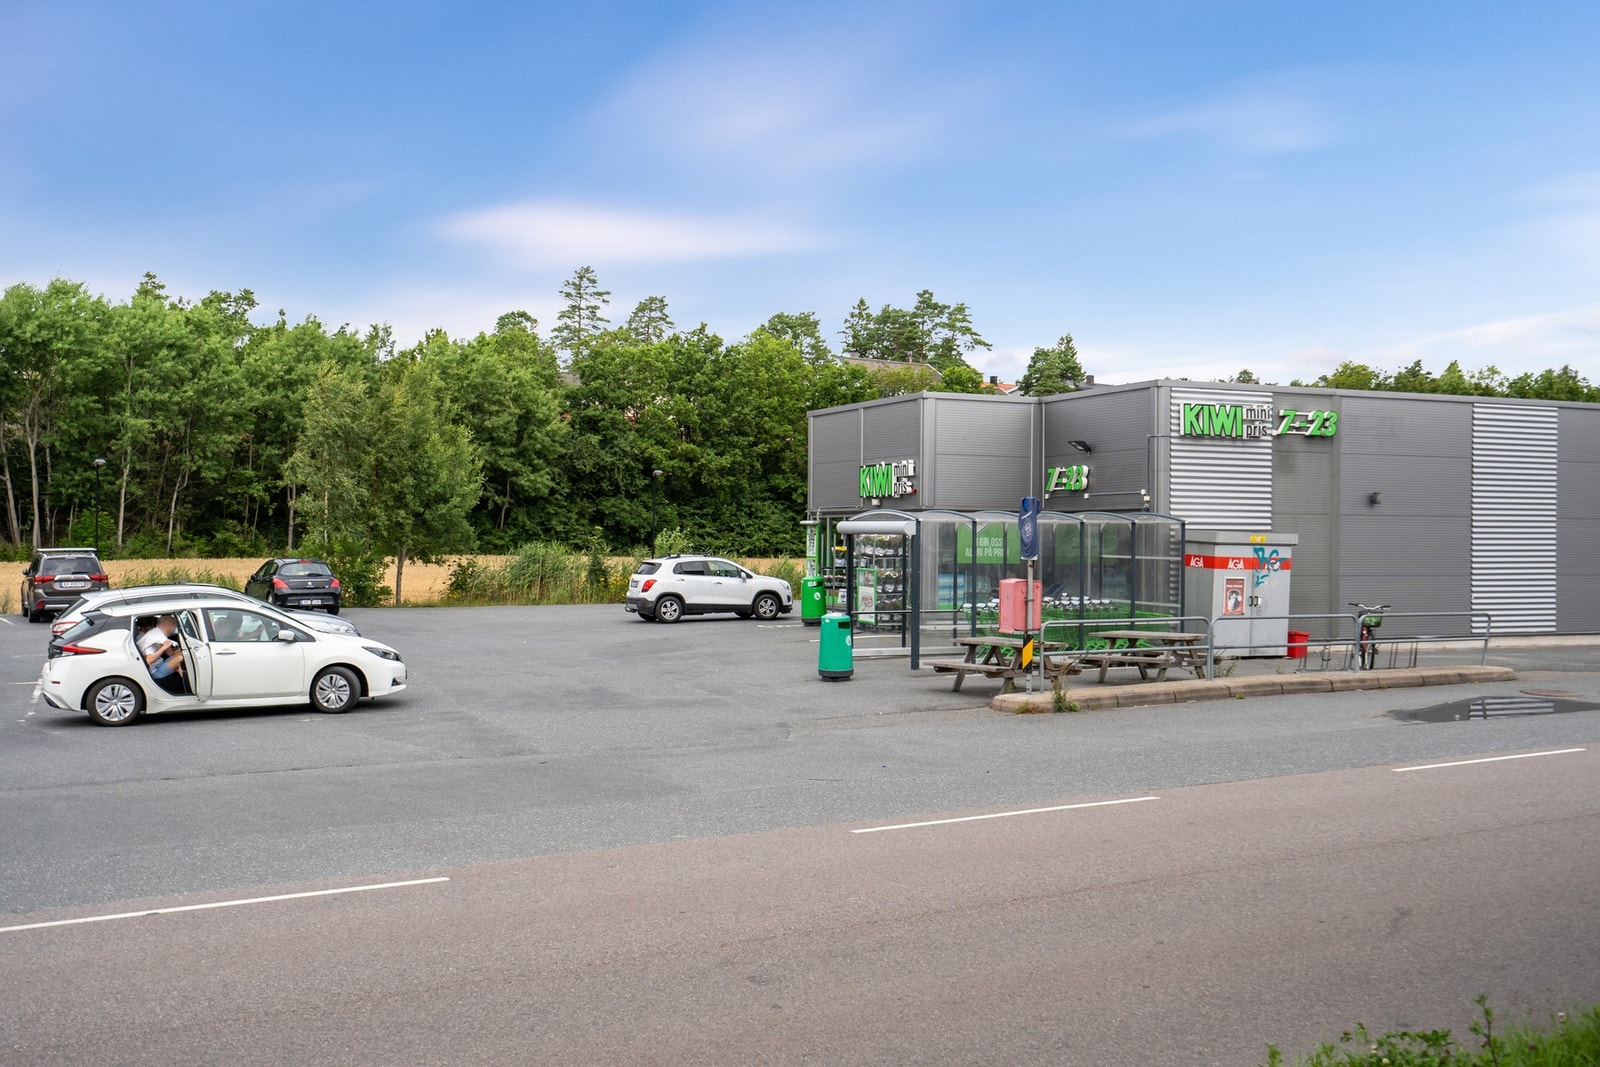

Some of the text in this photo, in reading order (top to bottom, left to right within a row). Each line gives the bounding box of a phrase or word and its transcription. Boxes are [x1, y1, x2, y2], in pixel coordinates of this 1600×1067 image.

[1183, 403, 1271, 438] KIWI mini
[1246, 422, 1268, 438] pris
[1278, 409, 1339, 438] 7-23
[859, 463, 892, 498] KIWI
[894, 478, 910, 498] pris
[1046, 465, 1086, 491] 7-23
[965, 547, 984, 557] ALRI
[1189, 556, 1204, 568] AGA
[1227, 558, 1245, 569] AGA
